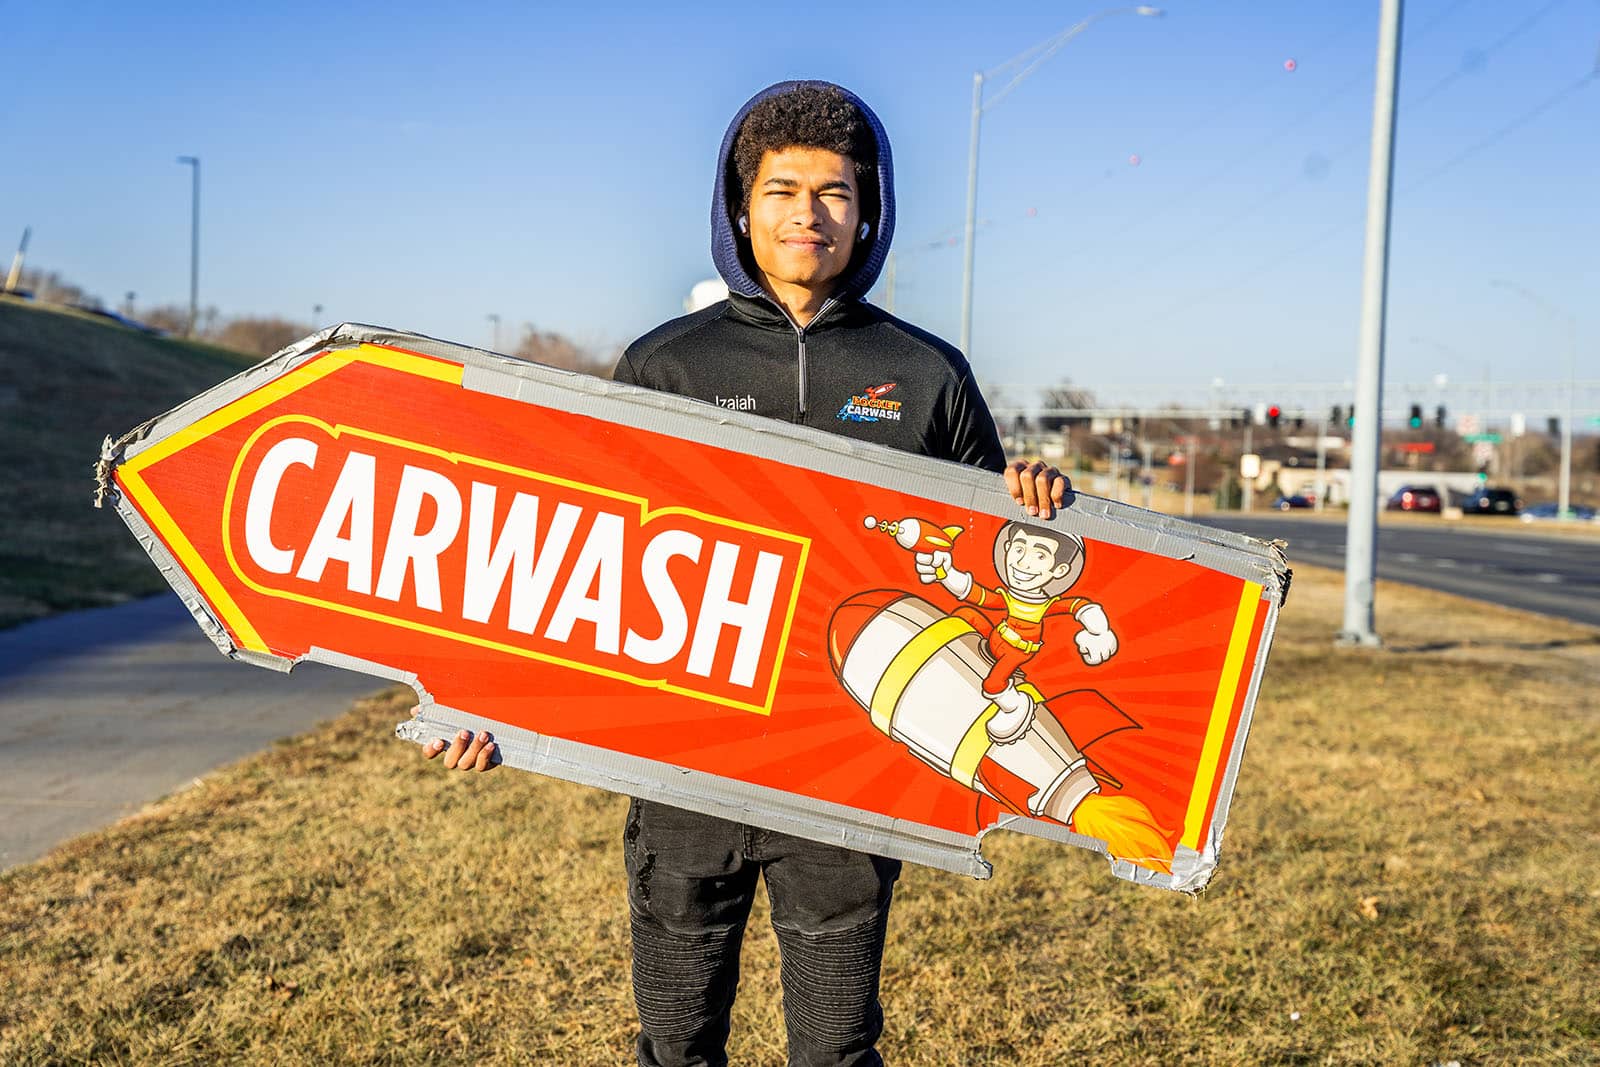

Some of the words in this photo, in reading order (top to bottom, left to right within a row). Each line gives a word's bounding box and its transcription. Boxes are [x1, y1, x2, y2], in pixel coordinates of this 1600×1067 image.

[715, 394, 757, 411] Izaiah
[852, 395, 902, 411] ROCKET
[847, 405, 901, 421] CARWASH
[244, 437, 784, 688] CARWASH
